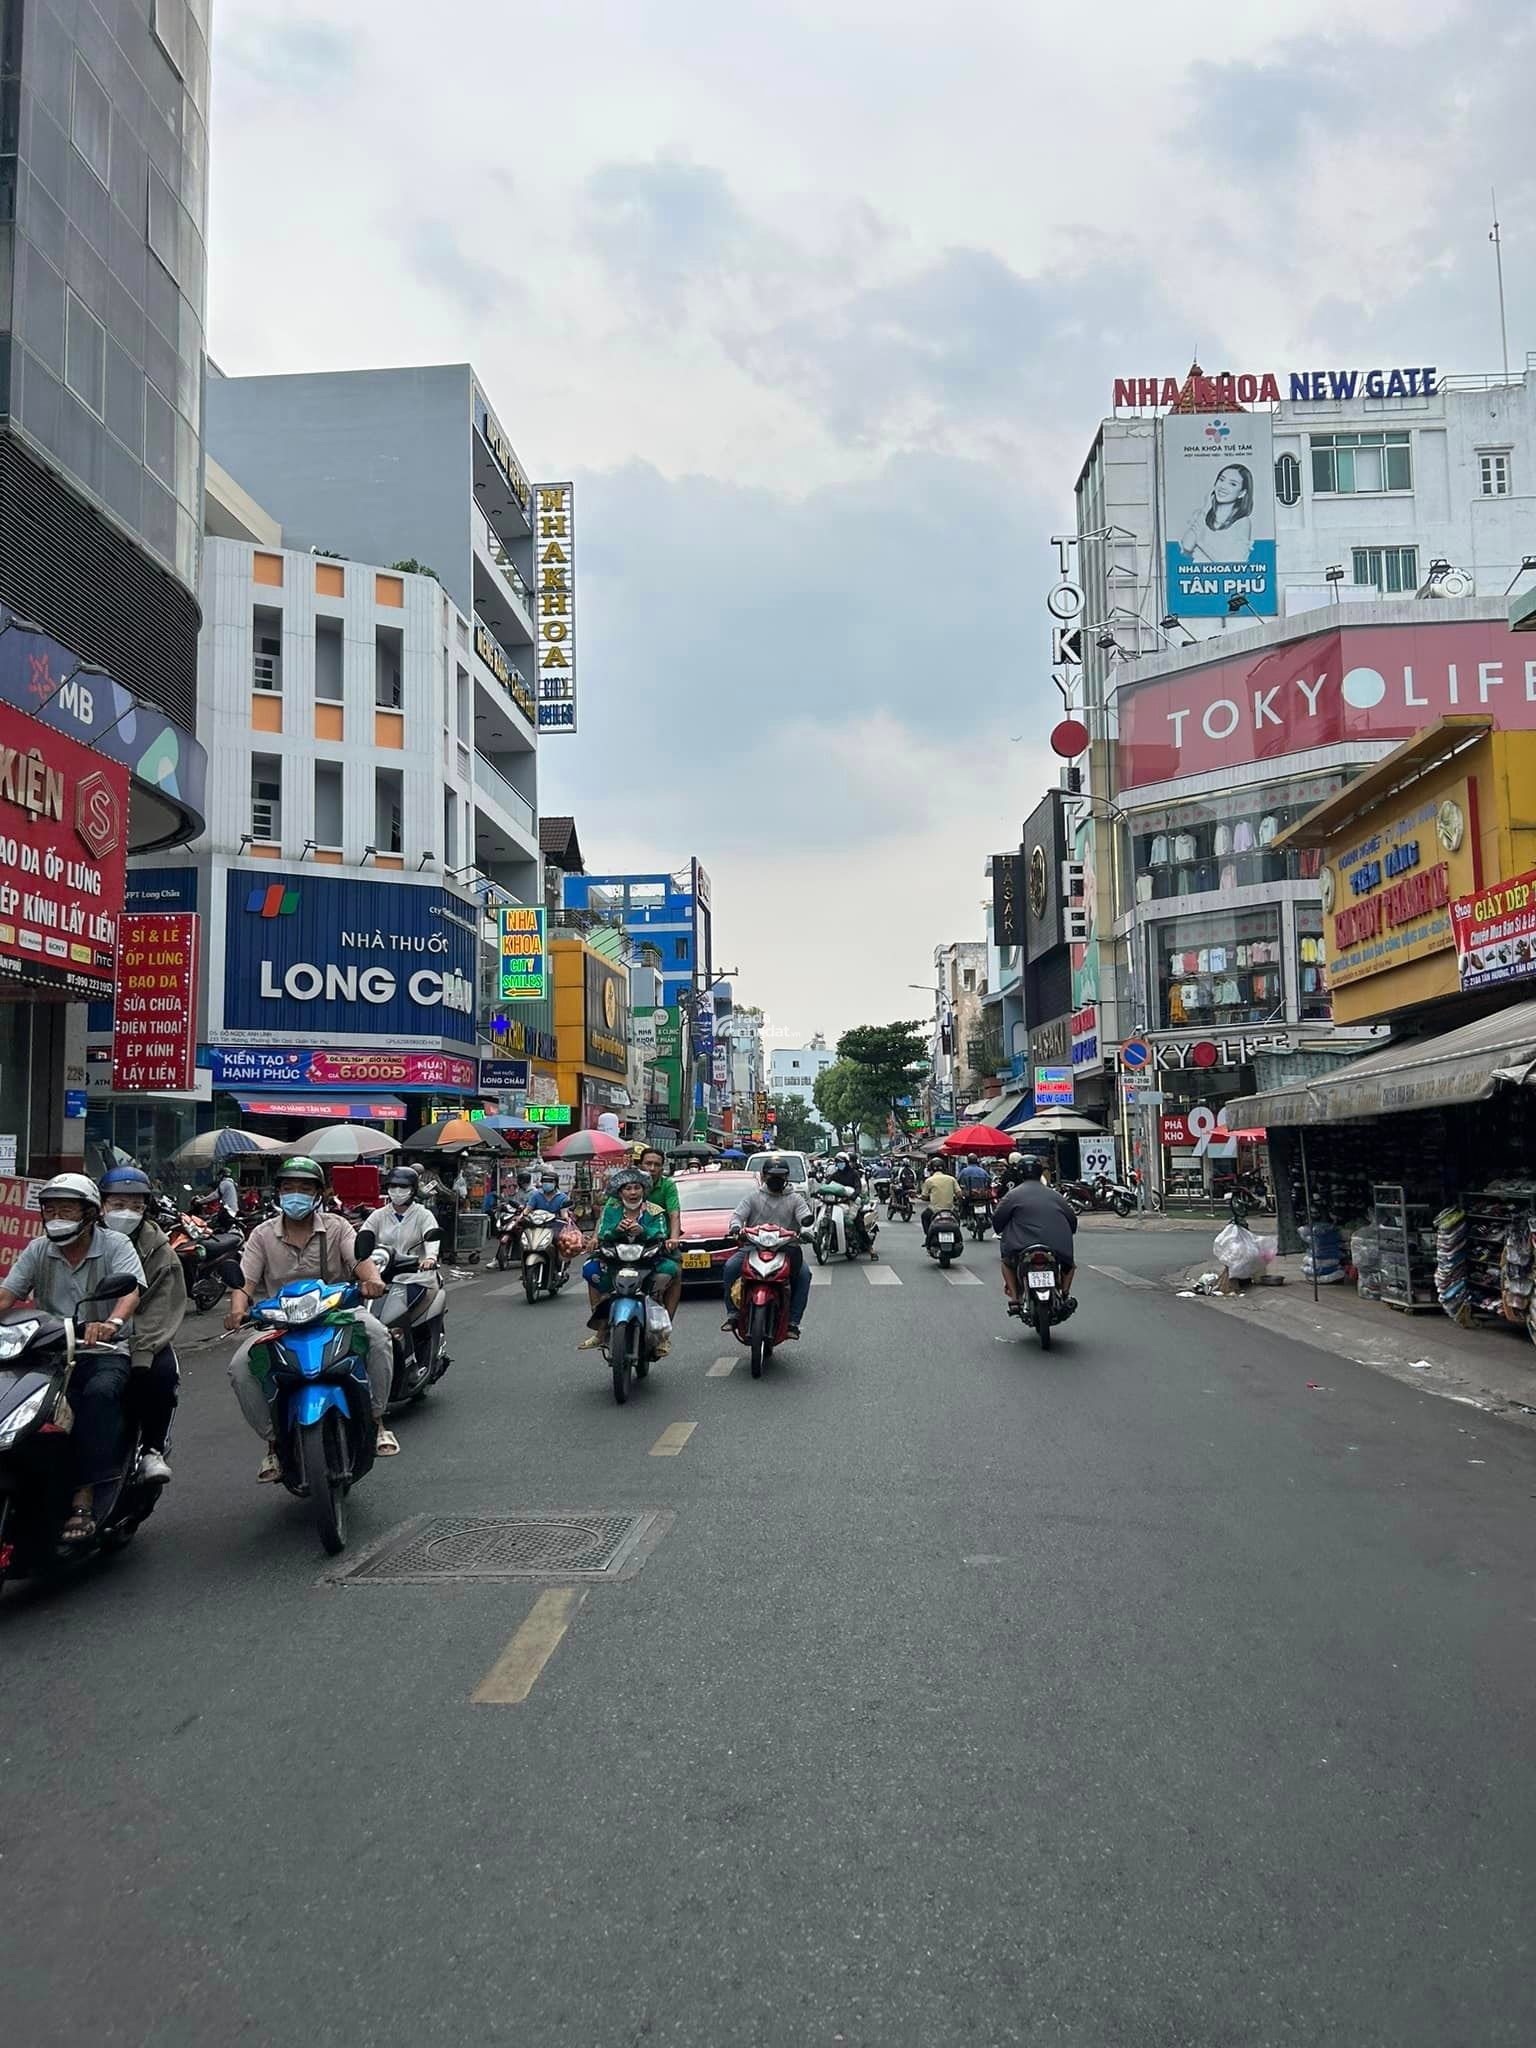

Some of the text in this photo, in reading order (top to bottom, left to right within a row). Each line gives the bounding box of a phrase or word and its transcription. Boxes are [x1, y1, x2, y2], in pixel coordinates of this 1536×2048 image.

[1114, 368, 1438, 407] NHA KHOA NEW GATE
[1179, 562, 1266, 573] NHA KHOA UY TÍN
[1179, 576, 1266, 595] TÂN PHÚ
[60, 676, 94, 725] MB
[21, 843, 40, 876] DA
[44, 846, 64, 882] ỐP
[67, 861, 101, 897] LƯNG
[142, 891, 160, 900] Long
[1475, 891, 1503, 922] GIÀY
[1505, 881, 1530, 912] DÉP
[24, 891, 58, 928] KÍNH
[61, 901, 86, 936] LẤY
[89, 910, 116, 945] LIỀN
[506, 911, 537, 931] NHA
[149, 929, 159, 943] &
[342, 928, 385, 949] NHÀ
[503, 935, 541, 955] KHOA
[48, 944, 65, 954] SONY
[126, 945, 184, 966] ỐP LƯNG
[510, 958, 534, 972] CITY
[129, 975, 178, 988] BAO DA
[260, 961, 396, 1004] LONG
[123, 993, 181, 1011] SỬA CHỮA
[121, 1016, 182, 1037] ĐIỆN THOẠI
[127, 1040, 174, 1057] ÉP KÍNH
[223, 1049, 284, 1068] KIẾN TẠO
[123, 1061, 176, 1081] LẤY LIỀN
[222, 1066, 300, 1080] HẠNH PHÚC
[340, 1065, 406, 1079] 6.000Đ
[482, 1075, 525, 1085] LONG CHÂU
[1036, 1094, 1053, 1103] NEW
[1164, 1131, 1184, 1141] KHO
